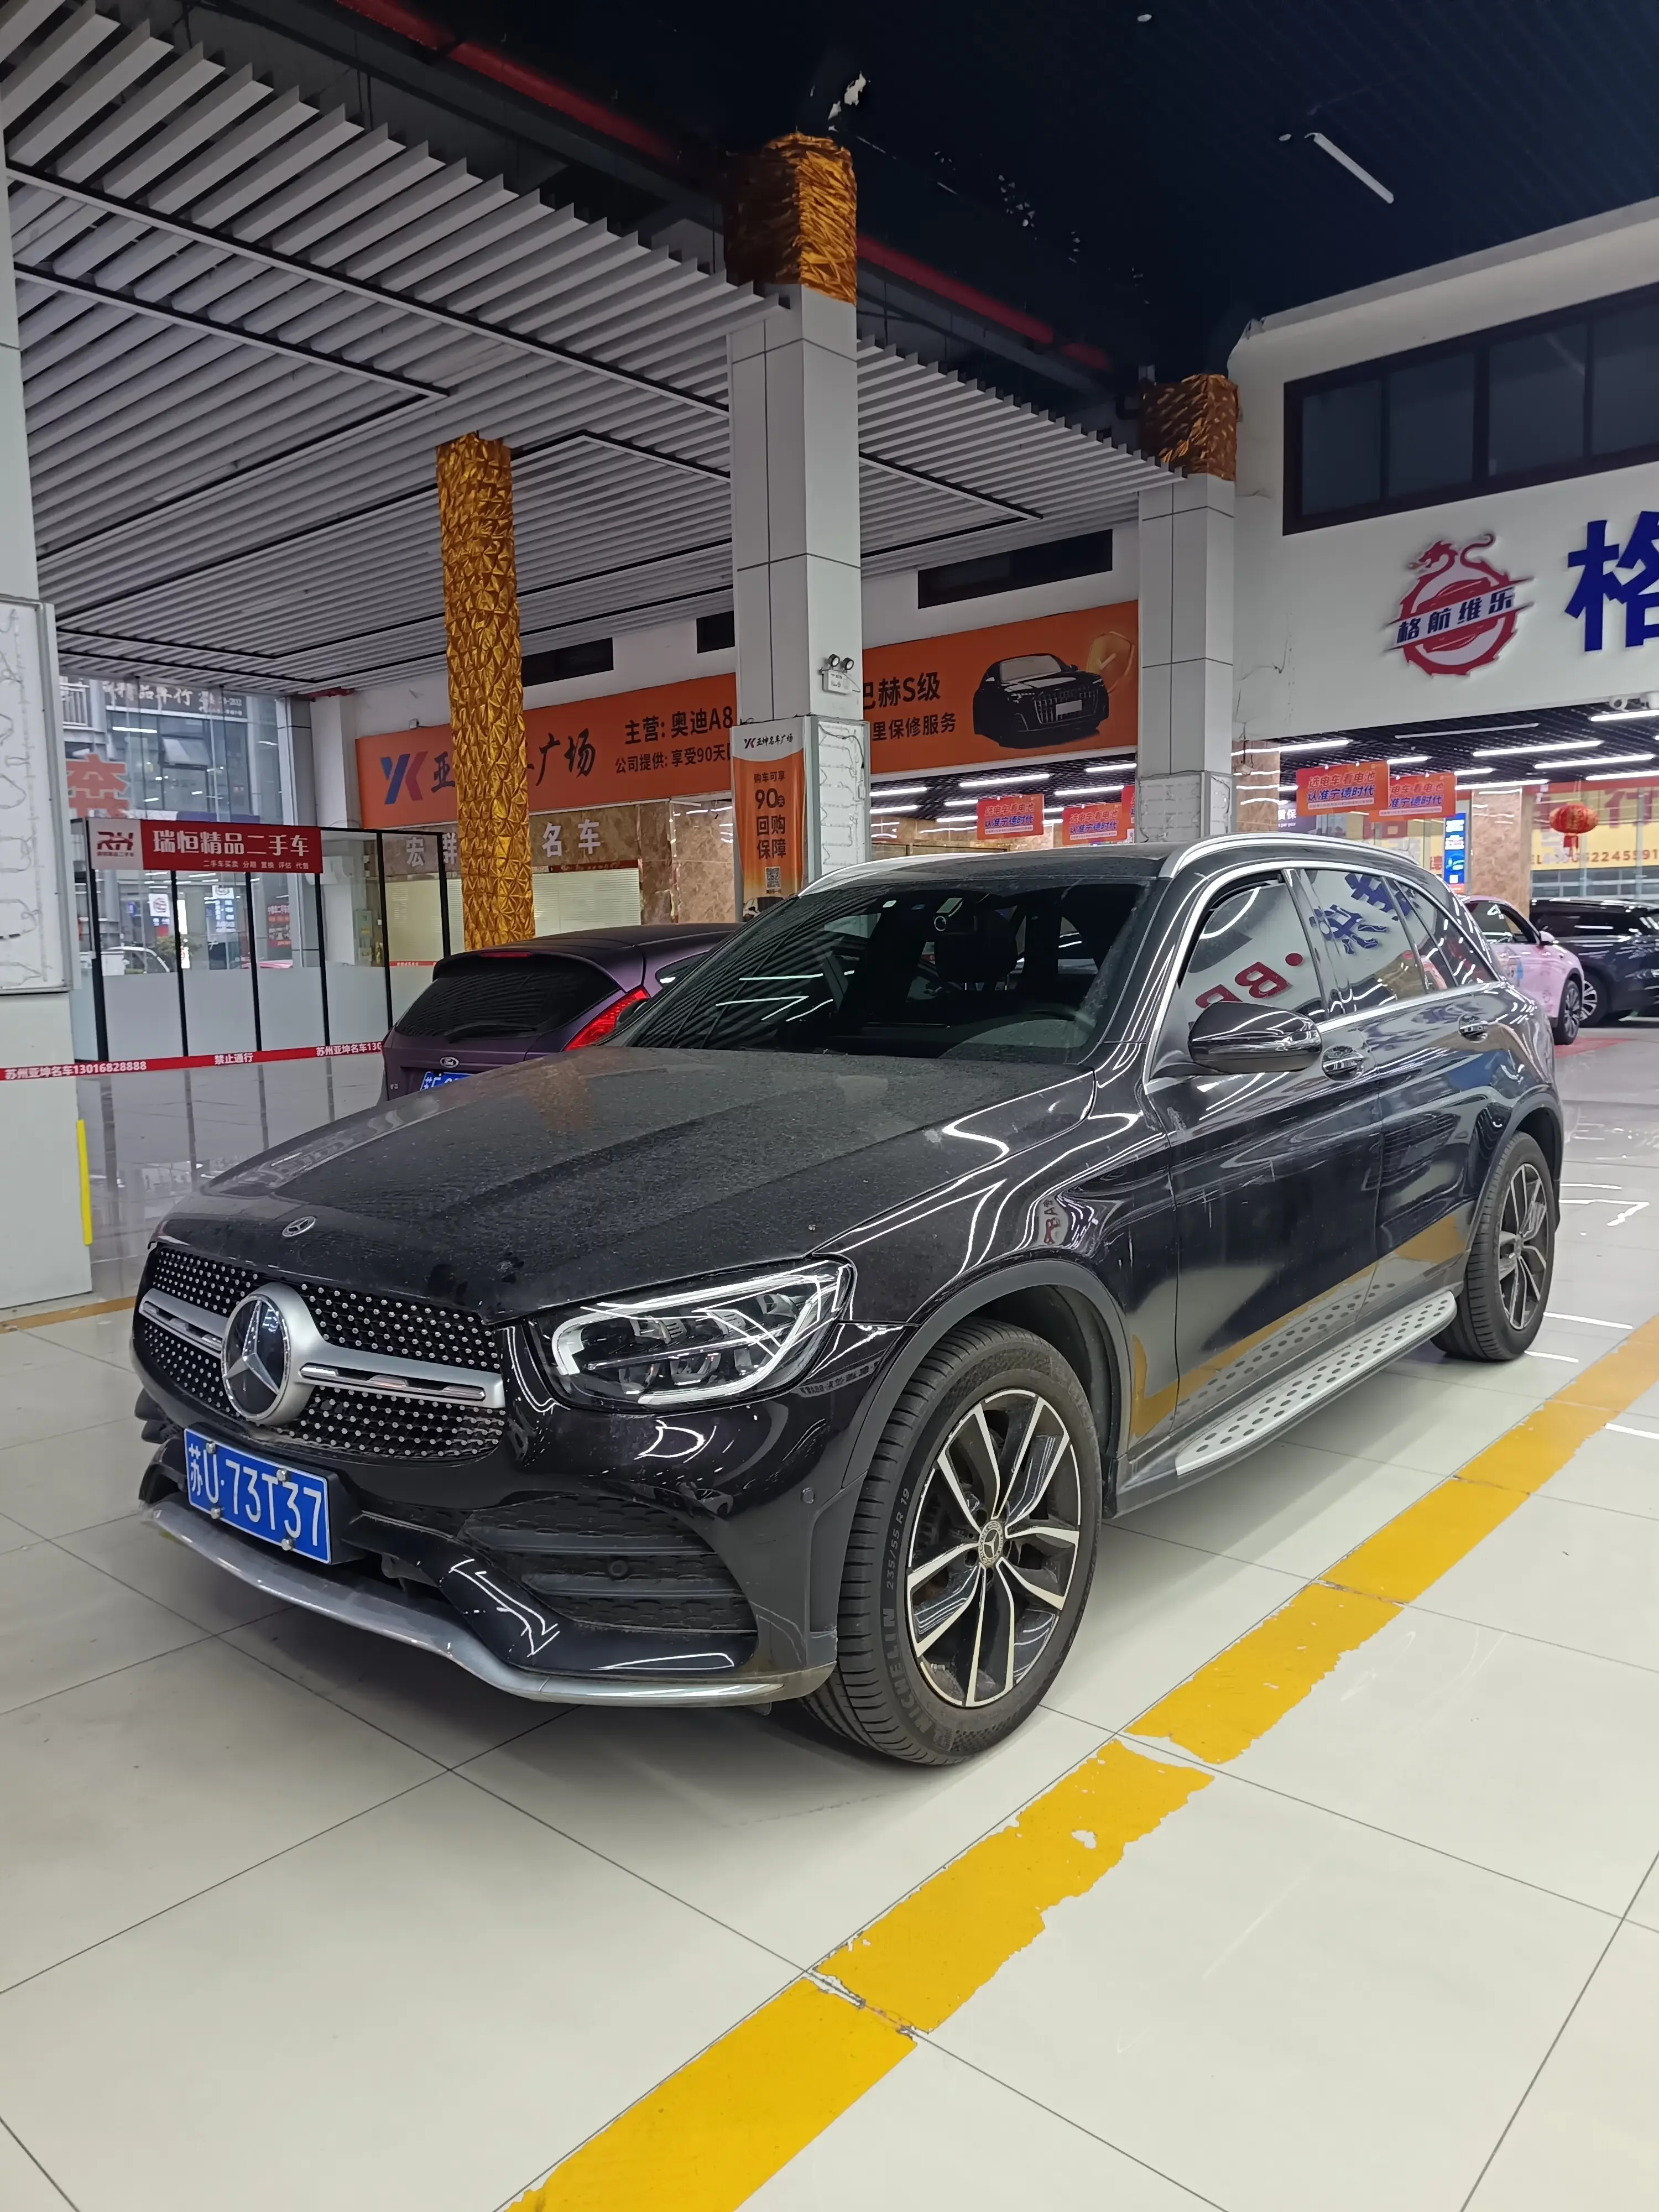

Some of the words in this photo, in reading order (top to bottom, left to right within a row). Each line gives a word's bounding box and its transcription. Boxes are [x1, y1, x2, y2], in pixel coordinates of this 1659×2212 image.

[1396, 586, 1514, 645] 格航维乐
[872, 712, 956, 742] 里保修服务
[615, 743, 731, 774] 公司提供：享受90天
[754, 770, 785, 783] 购车可享
[755, 787, 785, 810] 90天
[1307, 784, 1376, 802] 认准宁德时代
[1389, 781, 1444, 797] 电车看电池
[1389, 794, 1443, 808] 准宁德时代
[757, 815, 786, 836] 回购
[152, 830, 310, 857] 瑞恒精品二手车
[757, 839, 787, 860] 保障
[214, 1052, 254, 1066] 禁止通行
[4, 1061, 147, 1080] 苏州亚坤名车13016828888
[886, 1528, 900, 1590] 235/55
[896, 1511, 904, 1525] R
[900, 1488, 910, 1505] 19
[883, 1608, 933, 1734] MICHELIN
